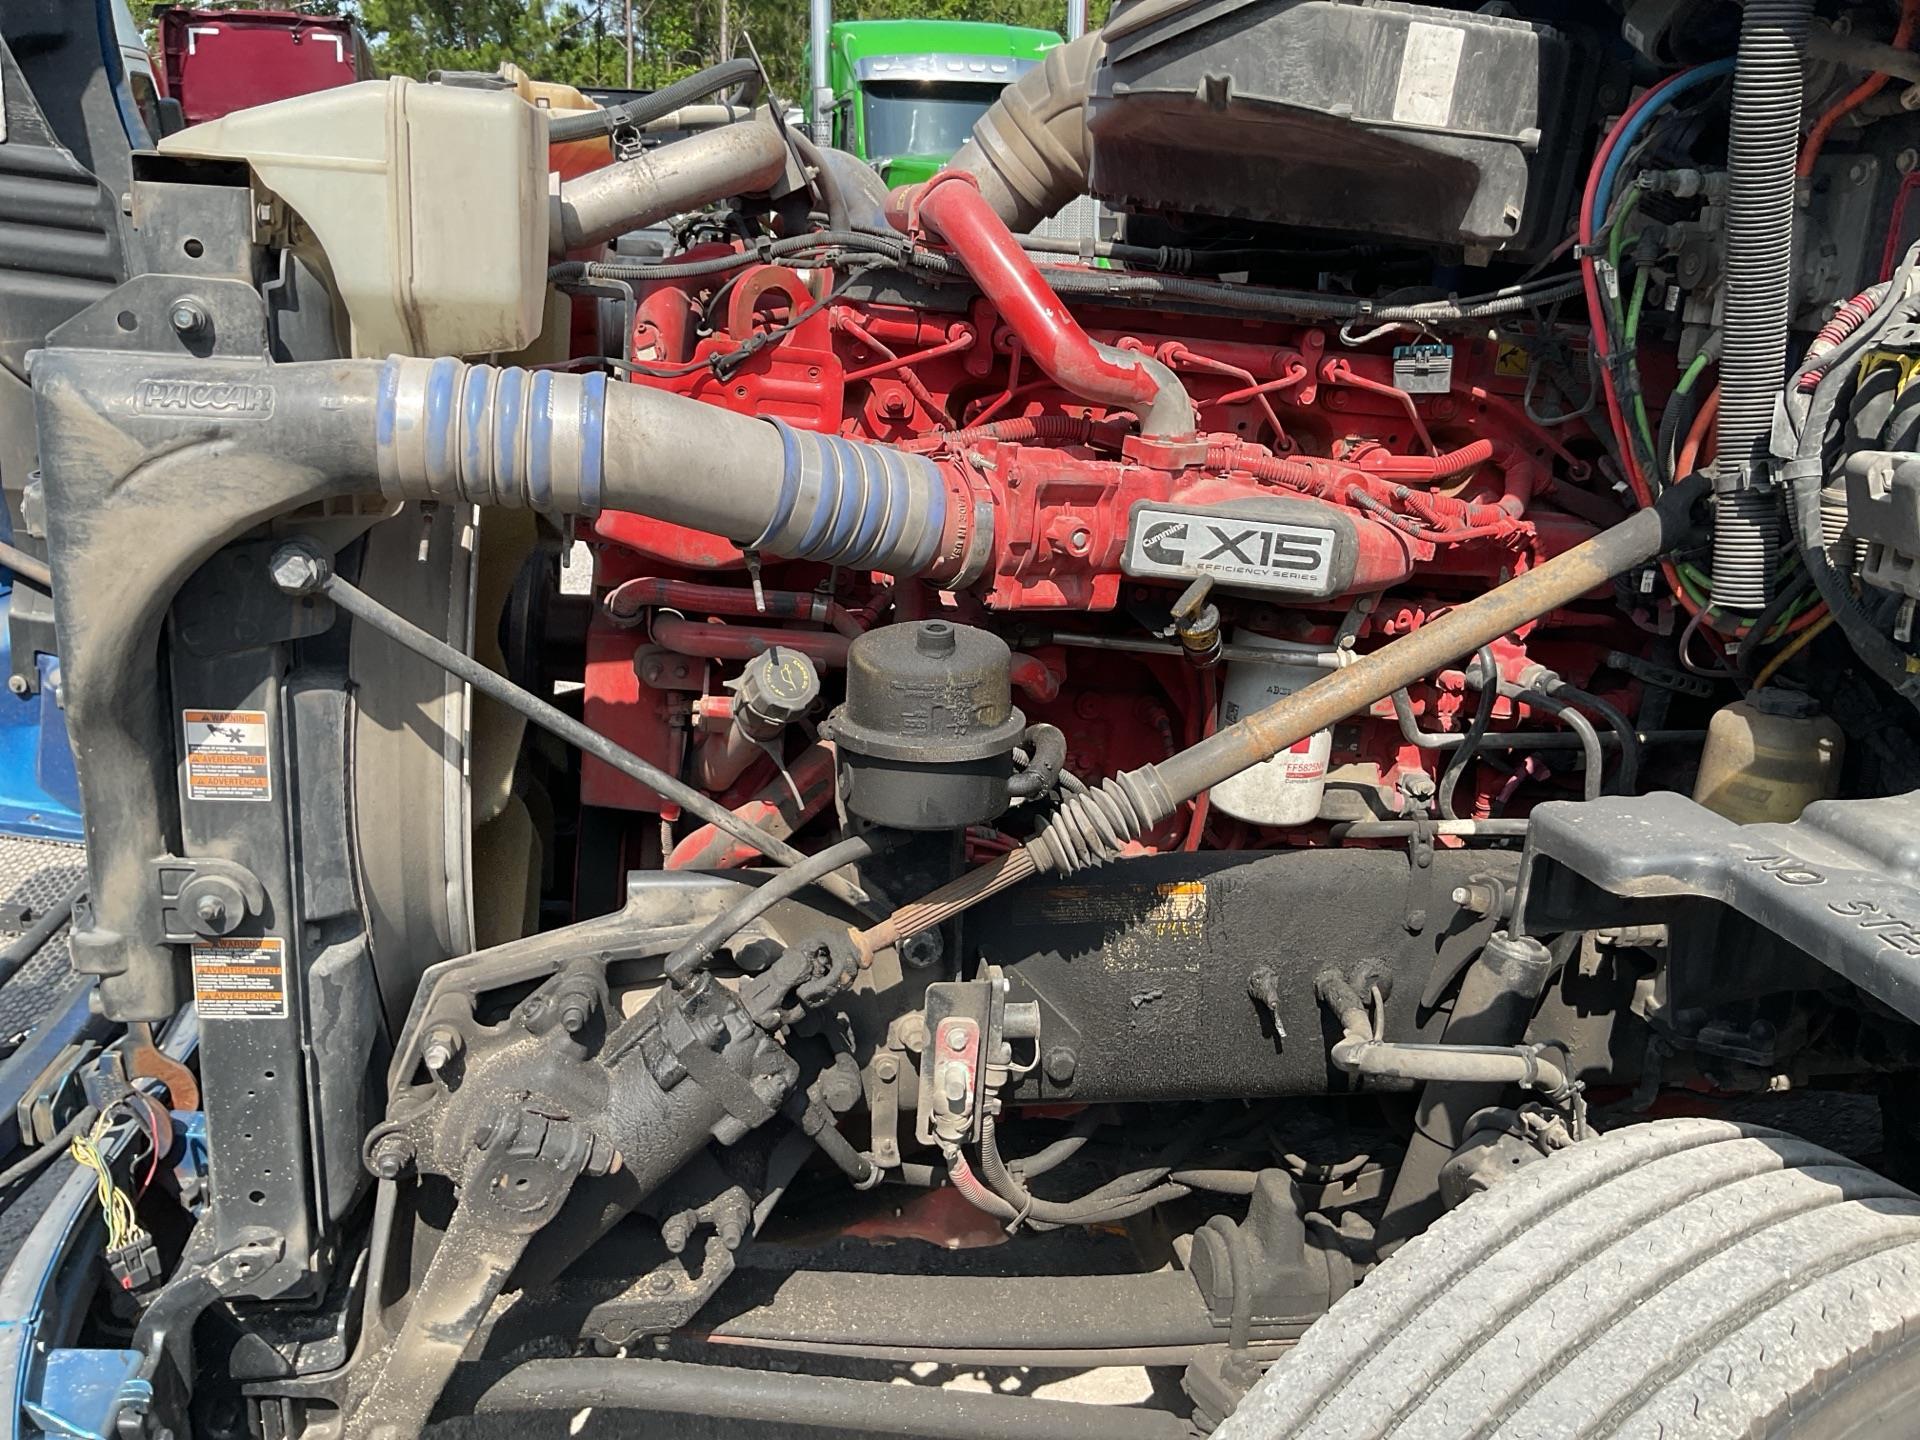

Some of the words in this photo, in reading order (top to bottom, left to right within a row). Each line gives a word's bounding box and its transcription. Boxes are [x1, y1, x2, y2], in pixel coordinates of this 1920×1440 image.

[143, 383, 272, 411] PACCAR
[957, 525, 967, 537] IN
[948, 541, 964, 560] USA
[1199, 525, 1323, 571] X15
[1197, 563, 1270, 576] EFFICIENCY
[1272, 570, 1318, 581] SERIES
[211, 712, 250, 723] WARNING
[208, 777, 263, 786] ADVERTENCIA
[1746, 854, 1827, 885] NO
